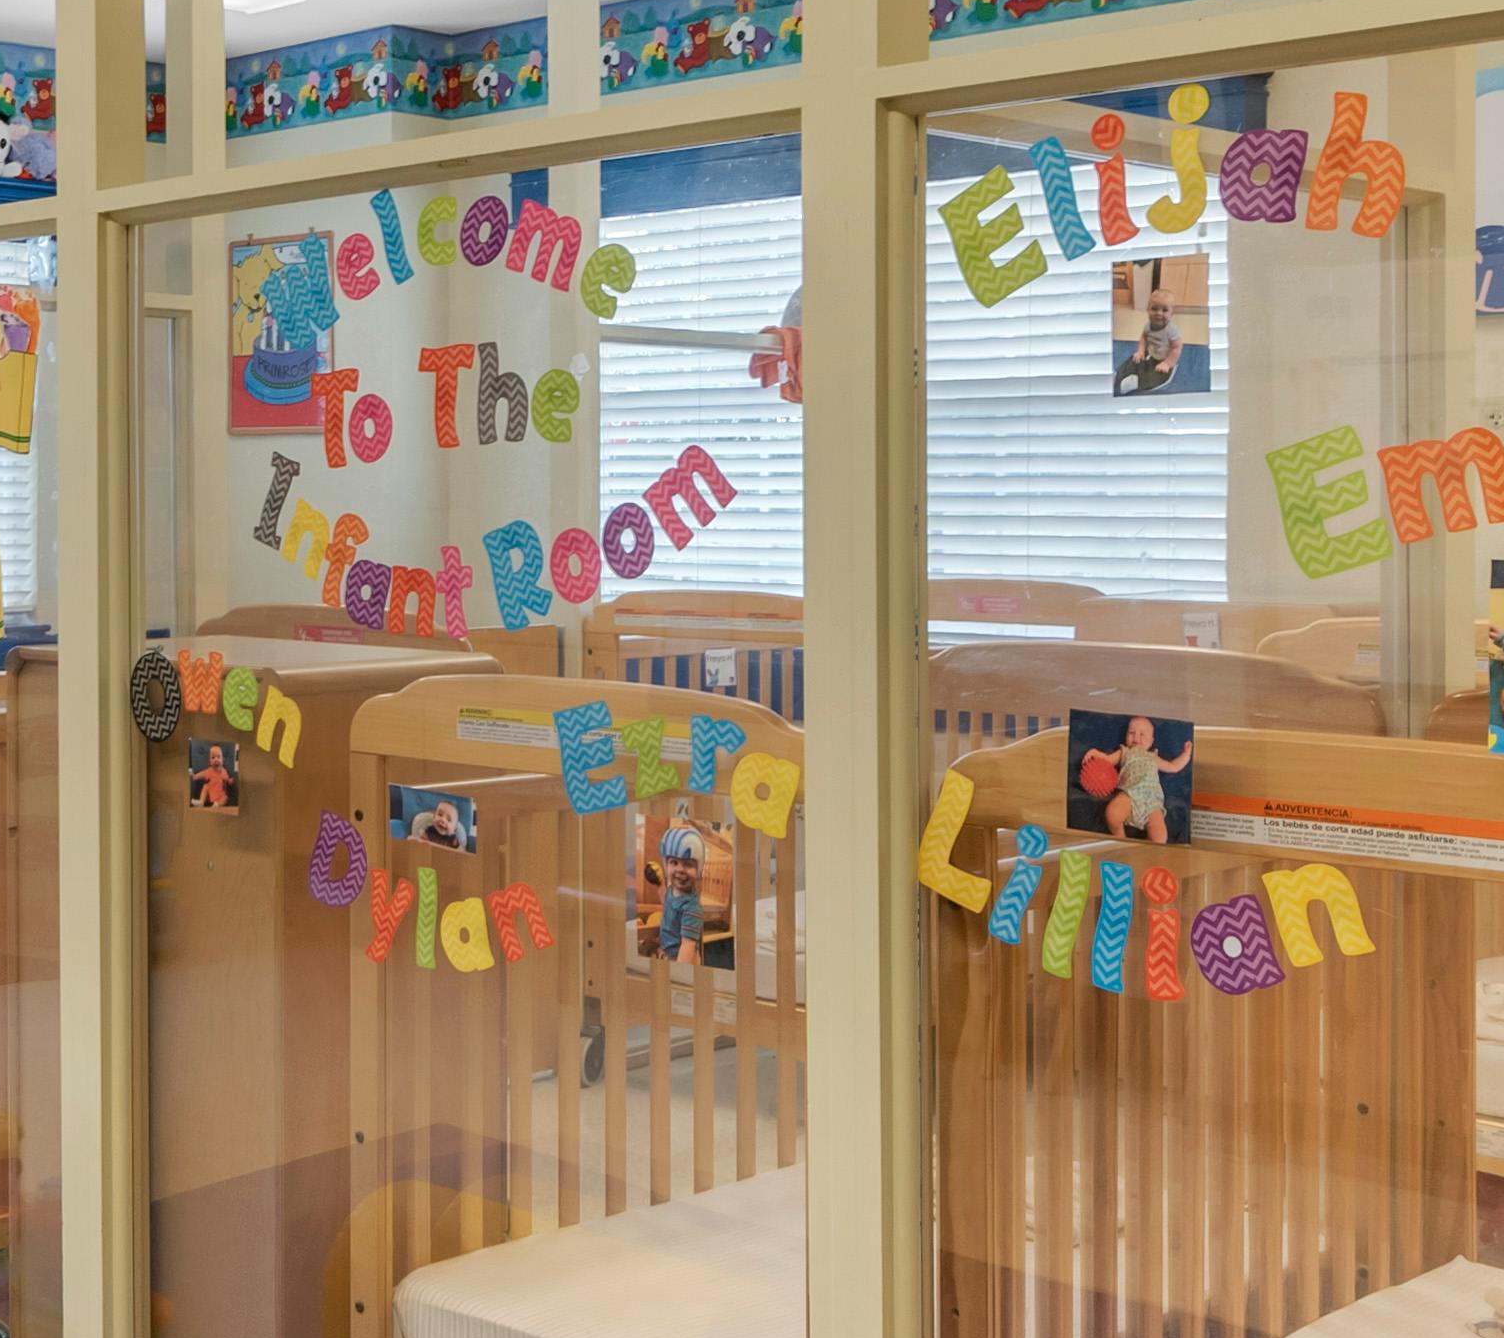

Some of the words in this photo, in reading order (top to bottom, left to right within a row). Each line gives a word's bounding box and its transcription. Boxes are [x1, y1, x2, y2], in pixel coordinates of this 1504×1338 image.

[260, 188, 637, 351] Welcome
[936, 83, 1407, 309] Elijah
[311, 368, 393, 469] To
[418, 341, 581, 448] The
[253, 451, 473, 640] Infant
[482, 444, 738, 631] Room
[131, 649, 302, 770] Owen
[554, 701, 801, 839] Ezra
[917, 767, 1377, 1002] Lillian
[1263, 818, 1280, 827] Los
[1311, 823, 1323, 831] de
[1325, 824, 1349, 834] corta
[1351, 827, 1374, 836] edad
[1376, 830, 1406, 840] puede
[1276, 803, 1352, 819] ADVERTENCIA:
[308, 809, 554, 973] Dylan
